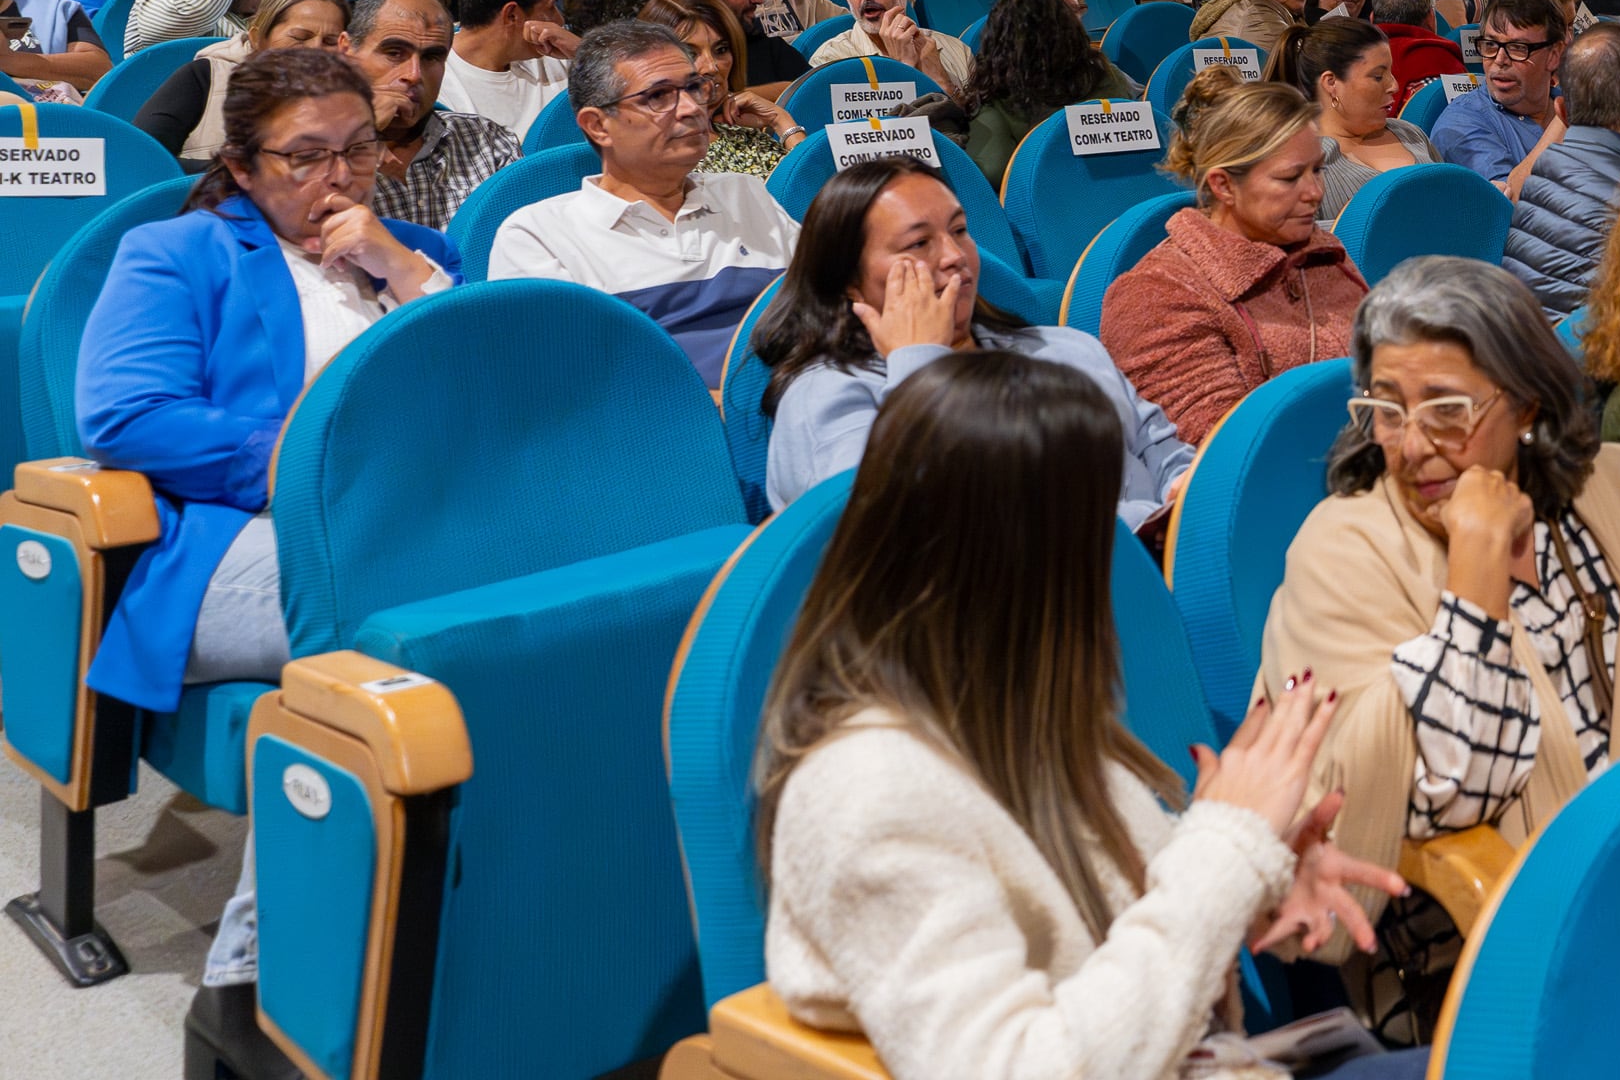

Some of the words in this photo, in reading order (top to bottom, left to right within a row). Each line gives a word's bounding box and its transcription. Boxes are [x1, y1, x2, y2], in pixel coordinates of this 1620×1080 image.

[844, 90, 903, 102] RESERVADO
[837, 108, 873, 120] COMI-K
[1080, 110, 1140, 126] RESERVADO
[844, 128, 915, 145] RESERVADO
[1074, 131, 1113, 146] COMI-K
[1114, 129, 1153, 143] TEATRO
[28, 172, 96, 185] TEATRO
